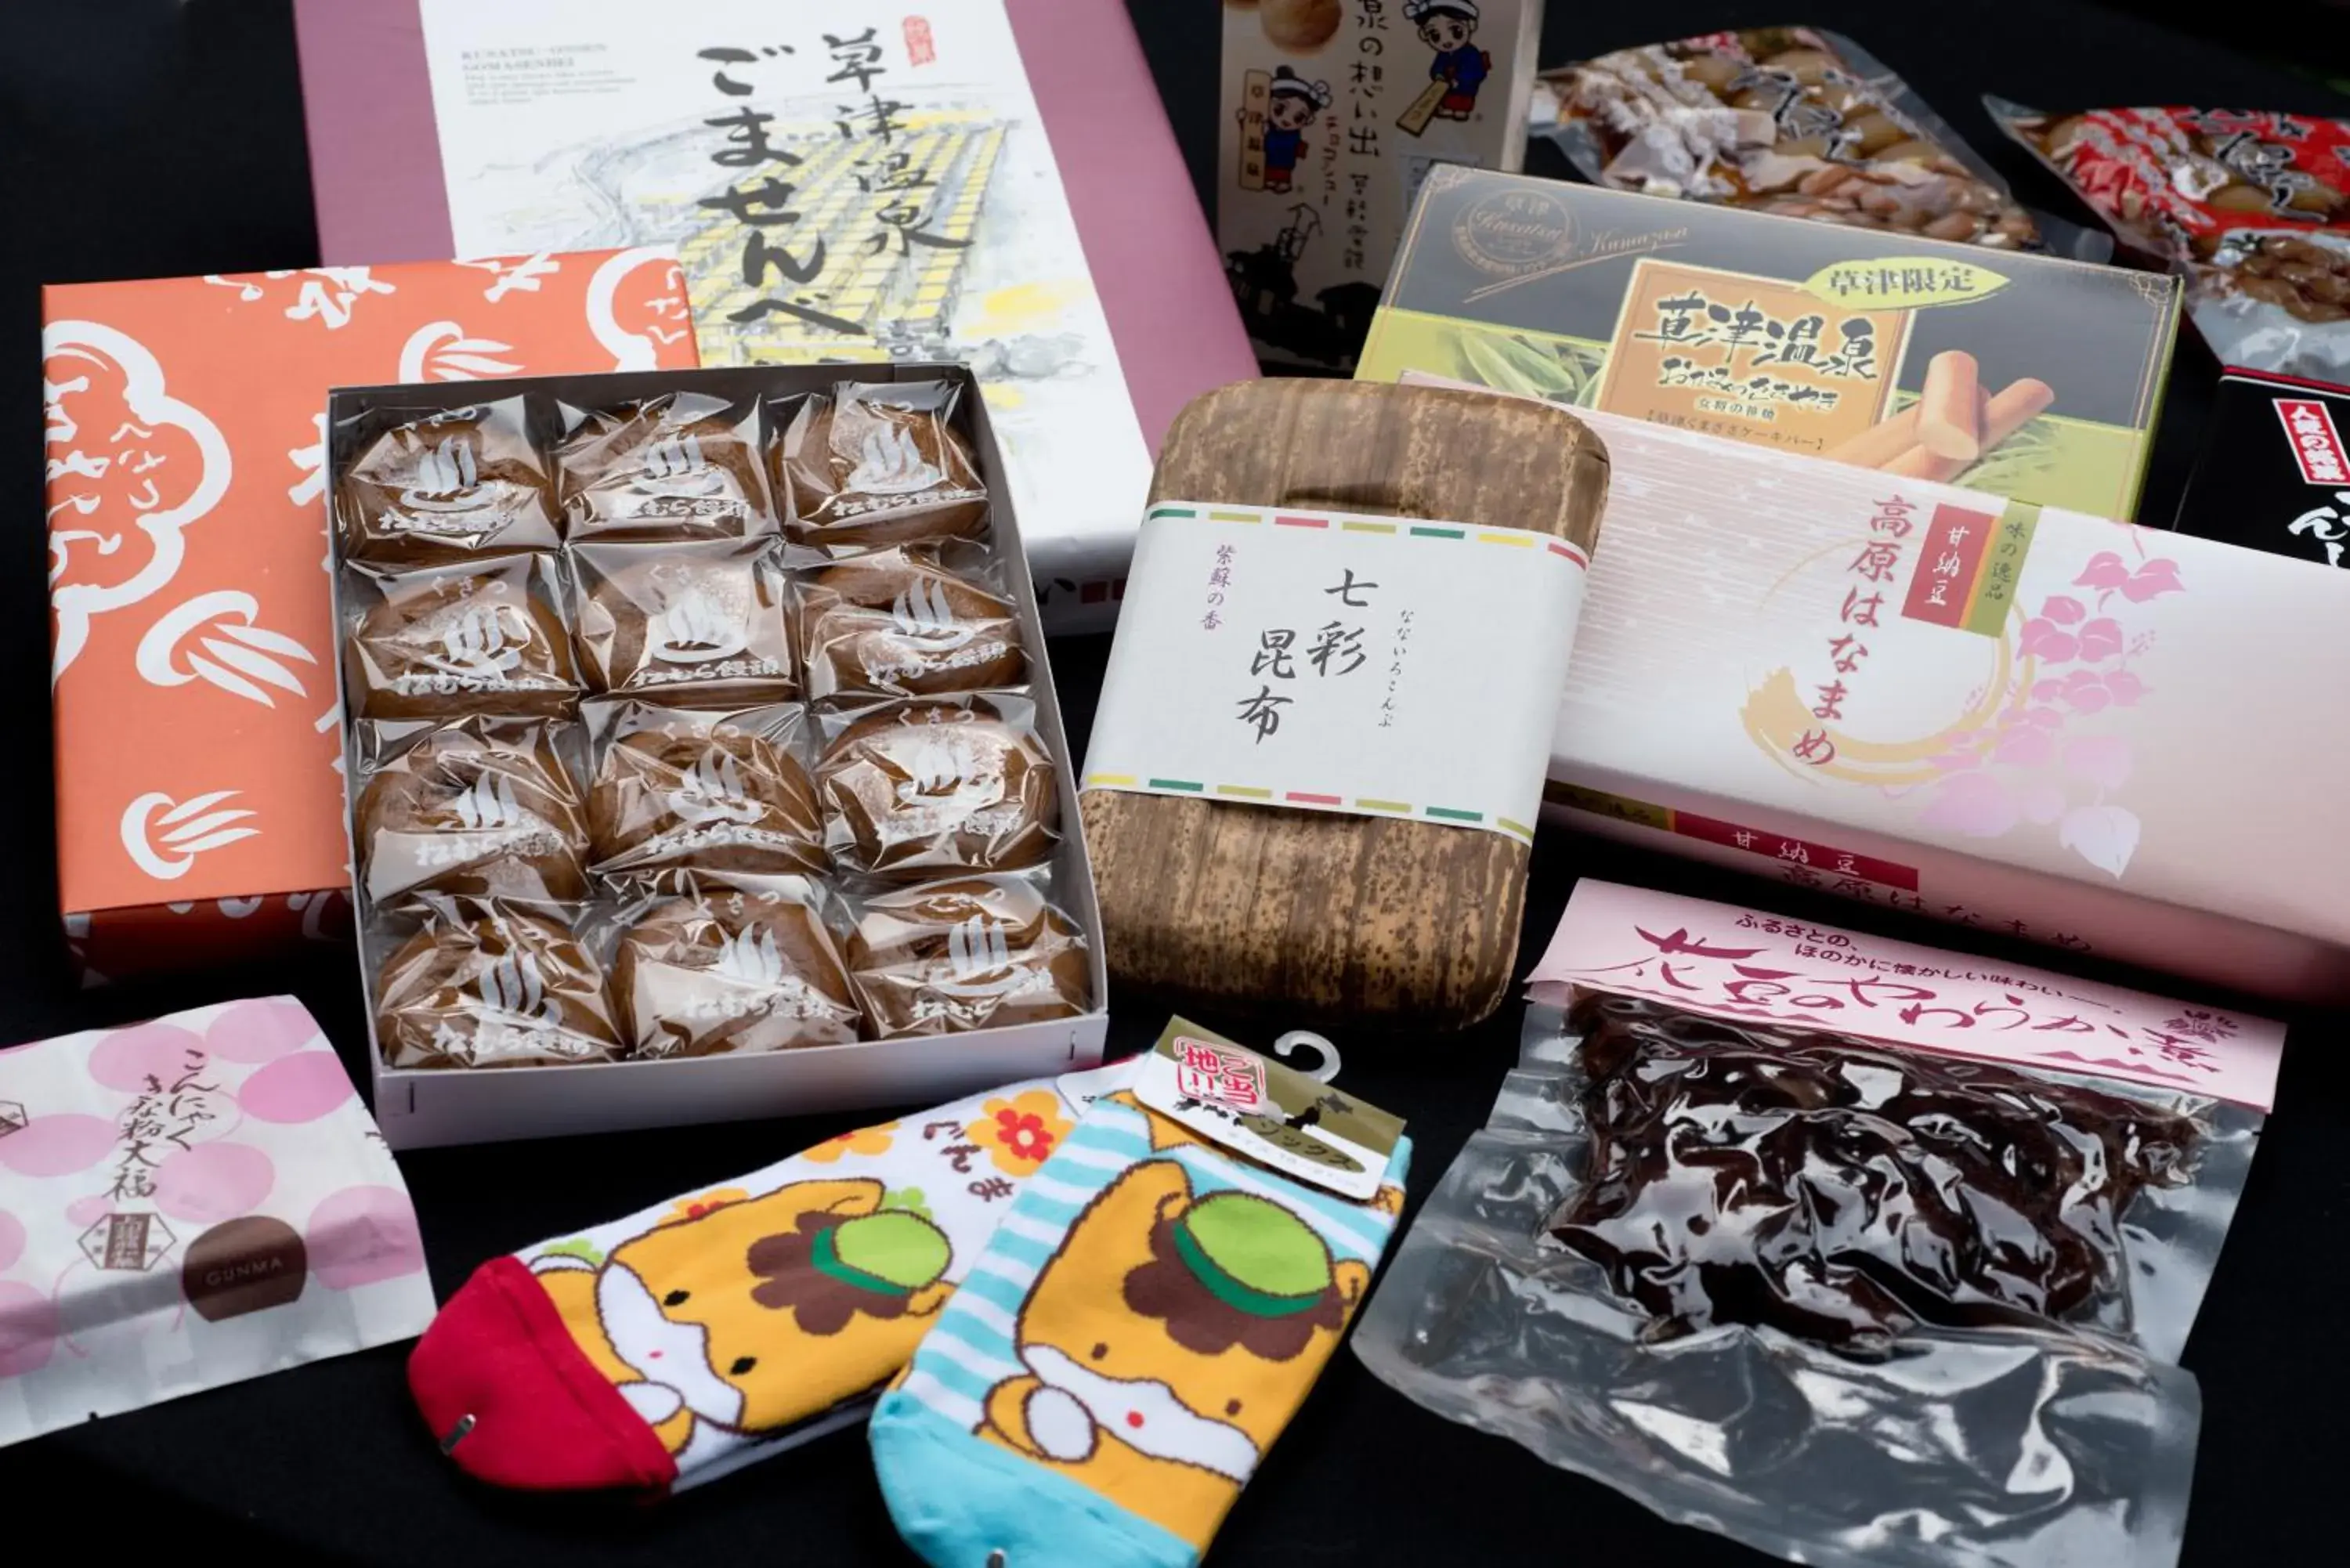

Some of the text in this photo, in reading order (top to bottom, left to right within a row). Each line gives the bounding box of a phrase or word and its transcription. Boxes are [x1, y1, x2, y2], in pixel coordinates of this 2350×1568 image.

[822, 27, 974, 257] 草津温泉
[696, 45, 867, 365] ごませんべ
[1830, 266, 1976, 296] 草津限定
[1634, 290, 1878, 379] 草津温泉
[1200, 544, 1237, 630] 紫蘇の香
[1924, 526, 1970, 607] 甘納豆
[1306, 569, 1379, 677] 七彩
[1378, 609, 1415, 728] なないろこんぶ
[1791, 494, 1918, 765] 高原はなまめ
[1236, 629, 1296, 745] 昆布
[1733, 830, 1861, 876] 甘納豆
[1735, 914, 1858, 952] ふるさとの、
[1564, 926, 2222, 1074] 花豆のやわらか煮
[101, 1073, 164, 1202] きな粉大福
[166, 1049, 221, 1152] こんにゃく
[1256, 1115, 1354, 1169] ソックス
[922, 1120, 1014, 1203] ぐんま
[206, 1258, 283, 1287] GUNMA
